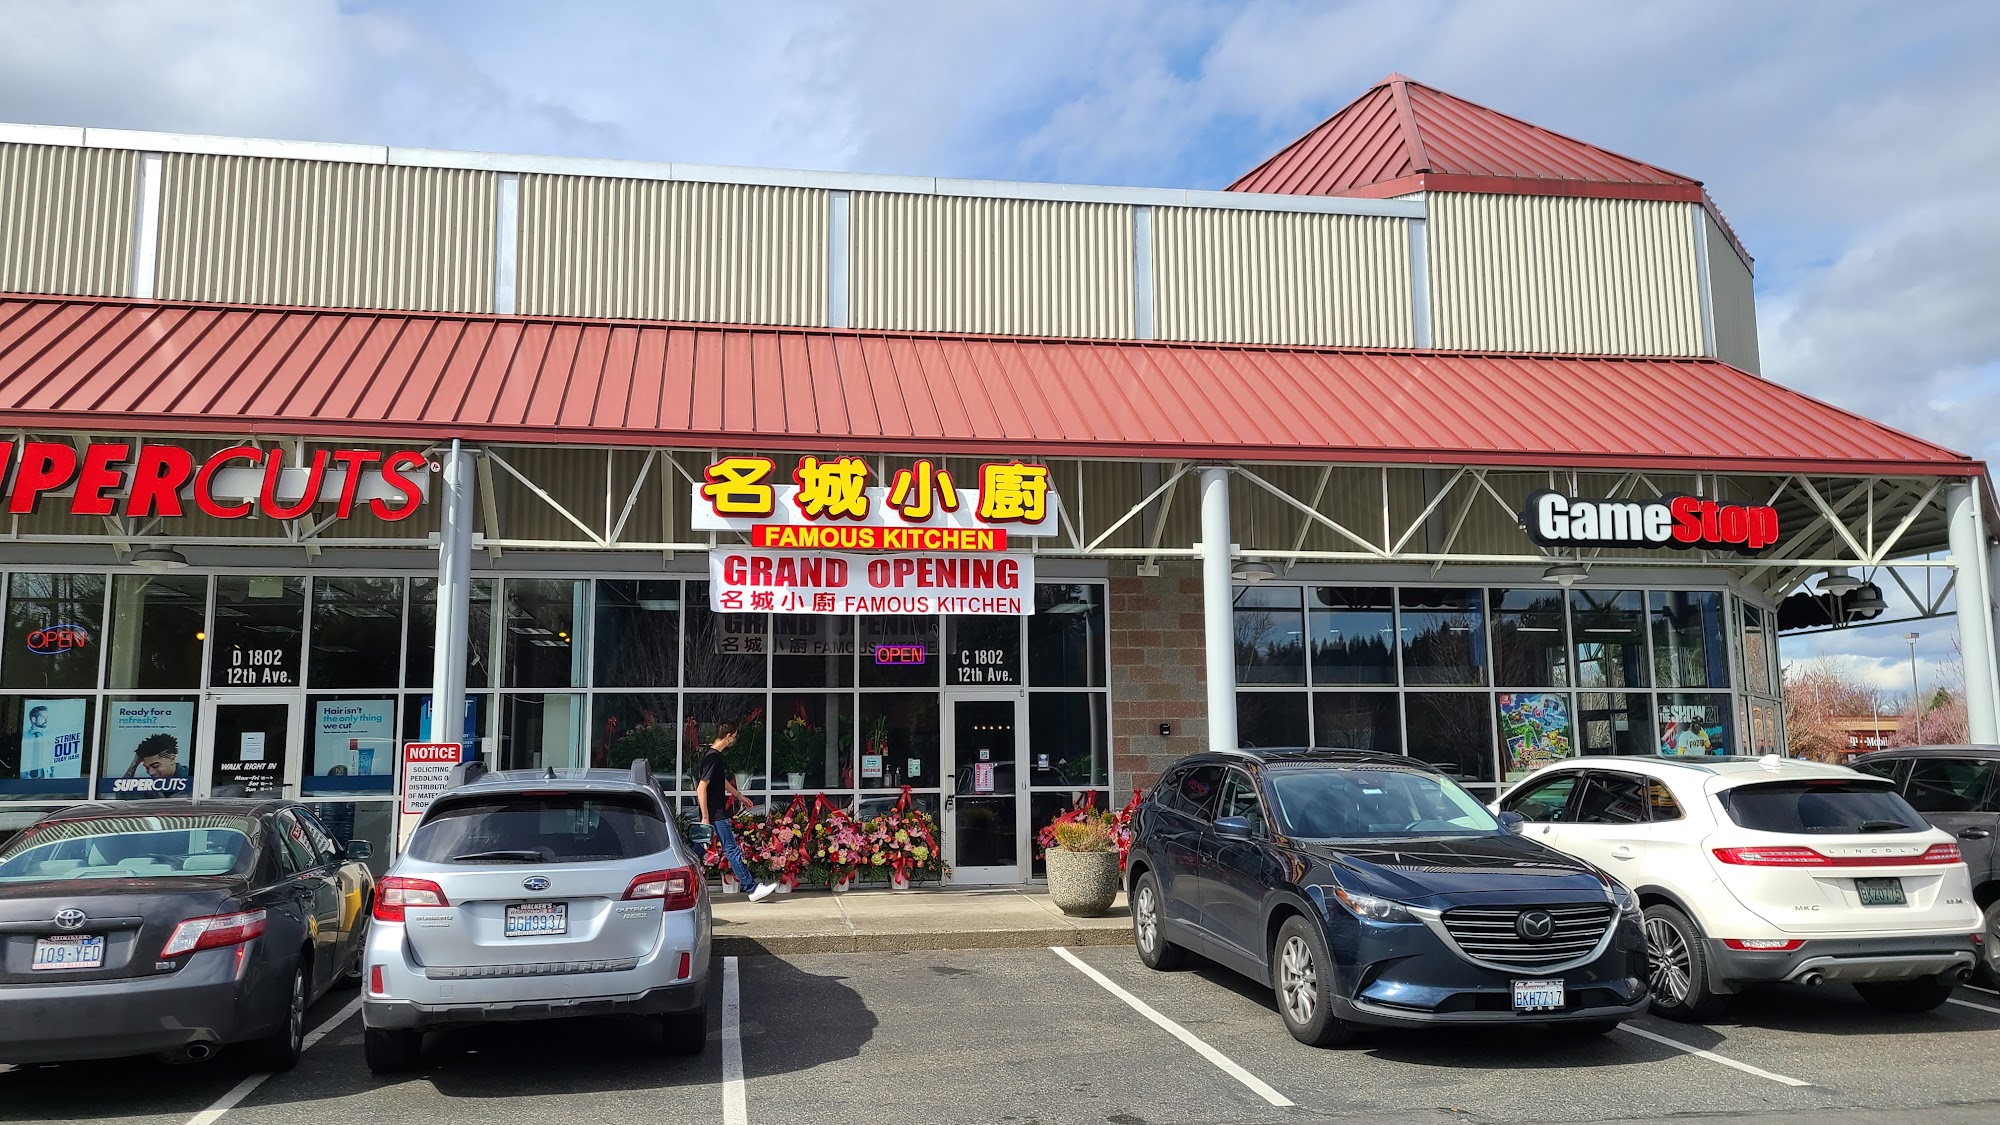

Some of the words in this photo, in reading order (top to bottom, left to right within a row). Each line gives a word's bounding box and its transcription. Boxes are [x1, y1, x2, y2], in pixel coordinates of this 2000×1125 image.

[0, 441, 428, 523] PERCUTS
[702, 455, 1050, 524] 名城小廚
[1538, 492, 1780, 549] GameStop
[765, 526, 875, 549] FAMOUS
[884, 528, 995, 551] KITCHEN
[723, 555, 849, 589] GRAND
[868, 556, 1019, 590] OPENING
[719, 590, 836, 613] 名城小廚
[845, 595, 929, 613] FAMOUS
[937, 596, 1022, 614] KITCHEN
[26, 630, 86, 649] OPEN
[232, 649, 242, 666] D
[248, 649, 283, 666] 1802
[877, 647, 923, 663] OPEN
[961, 649, 970, 665] C
[974, 649, 1004, 665] 1802
[227, 667, 257, 684] 12th
[261, 667, 292, 684] Ave.
[957, 667, 983, 682] 12th
[987, 667, 1013, 682] Ave.
[119, 707, 149, 718] Ready
[150, 707, 164, 716] for
[323, 707, 343, 715] Hair
[344, 706, 362, 714] isn't
[323, 714, 338, 722] the
[338, 714, 359, 724] only
[359, 713, 382, 723] thing
[1659, 712, 1671, 723] THE
[1670, 705, 1706, 723] SHOW
[1705, 705, 1719, 723] 21
[118, 716, 158, 724] refresh?
[338, 722, 353, 730] cut
[54, 732, 81, 744] STRIKE
[54, 740, 81, 758] OUT
[409, 747, 457, 760] NOTICE
[221, 763, 243, 771] WALK
[243, 762, 267, 770] RIGHT
[267, 762, 278, 770] IN
[112, 777, 188, 792] SUPERCUTS
[520, 902, 553, 910] WALKER'S
[508, 914, 563, 931] BGH9937
[1516, 990, 1562, 1006] BKH7717
